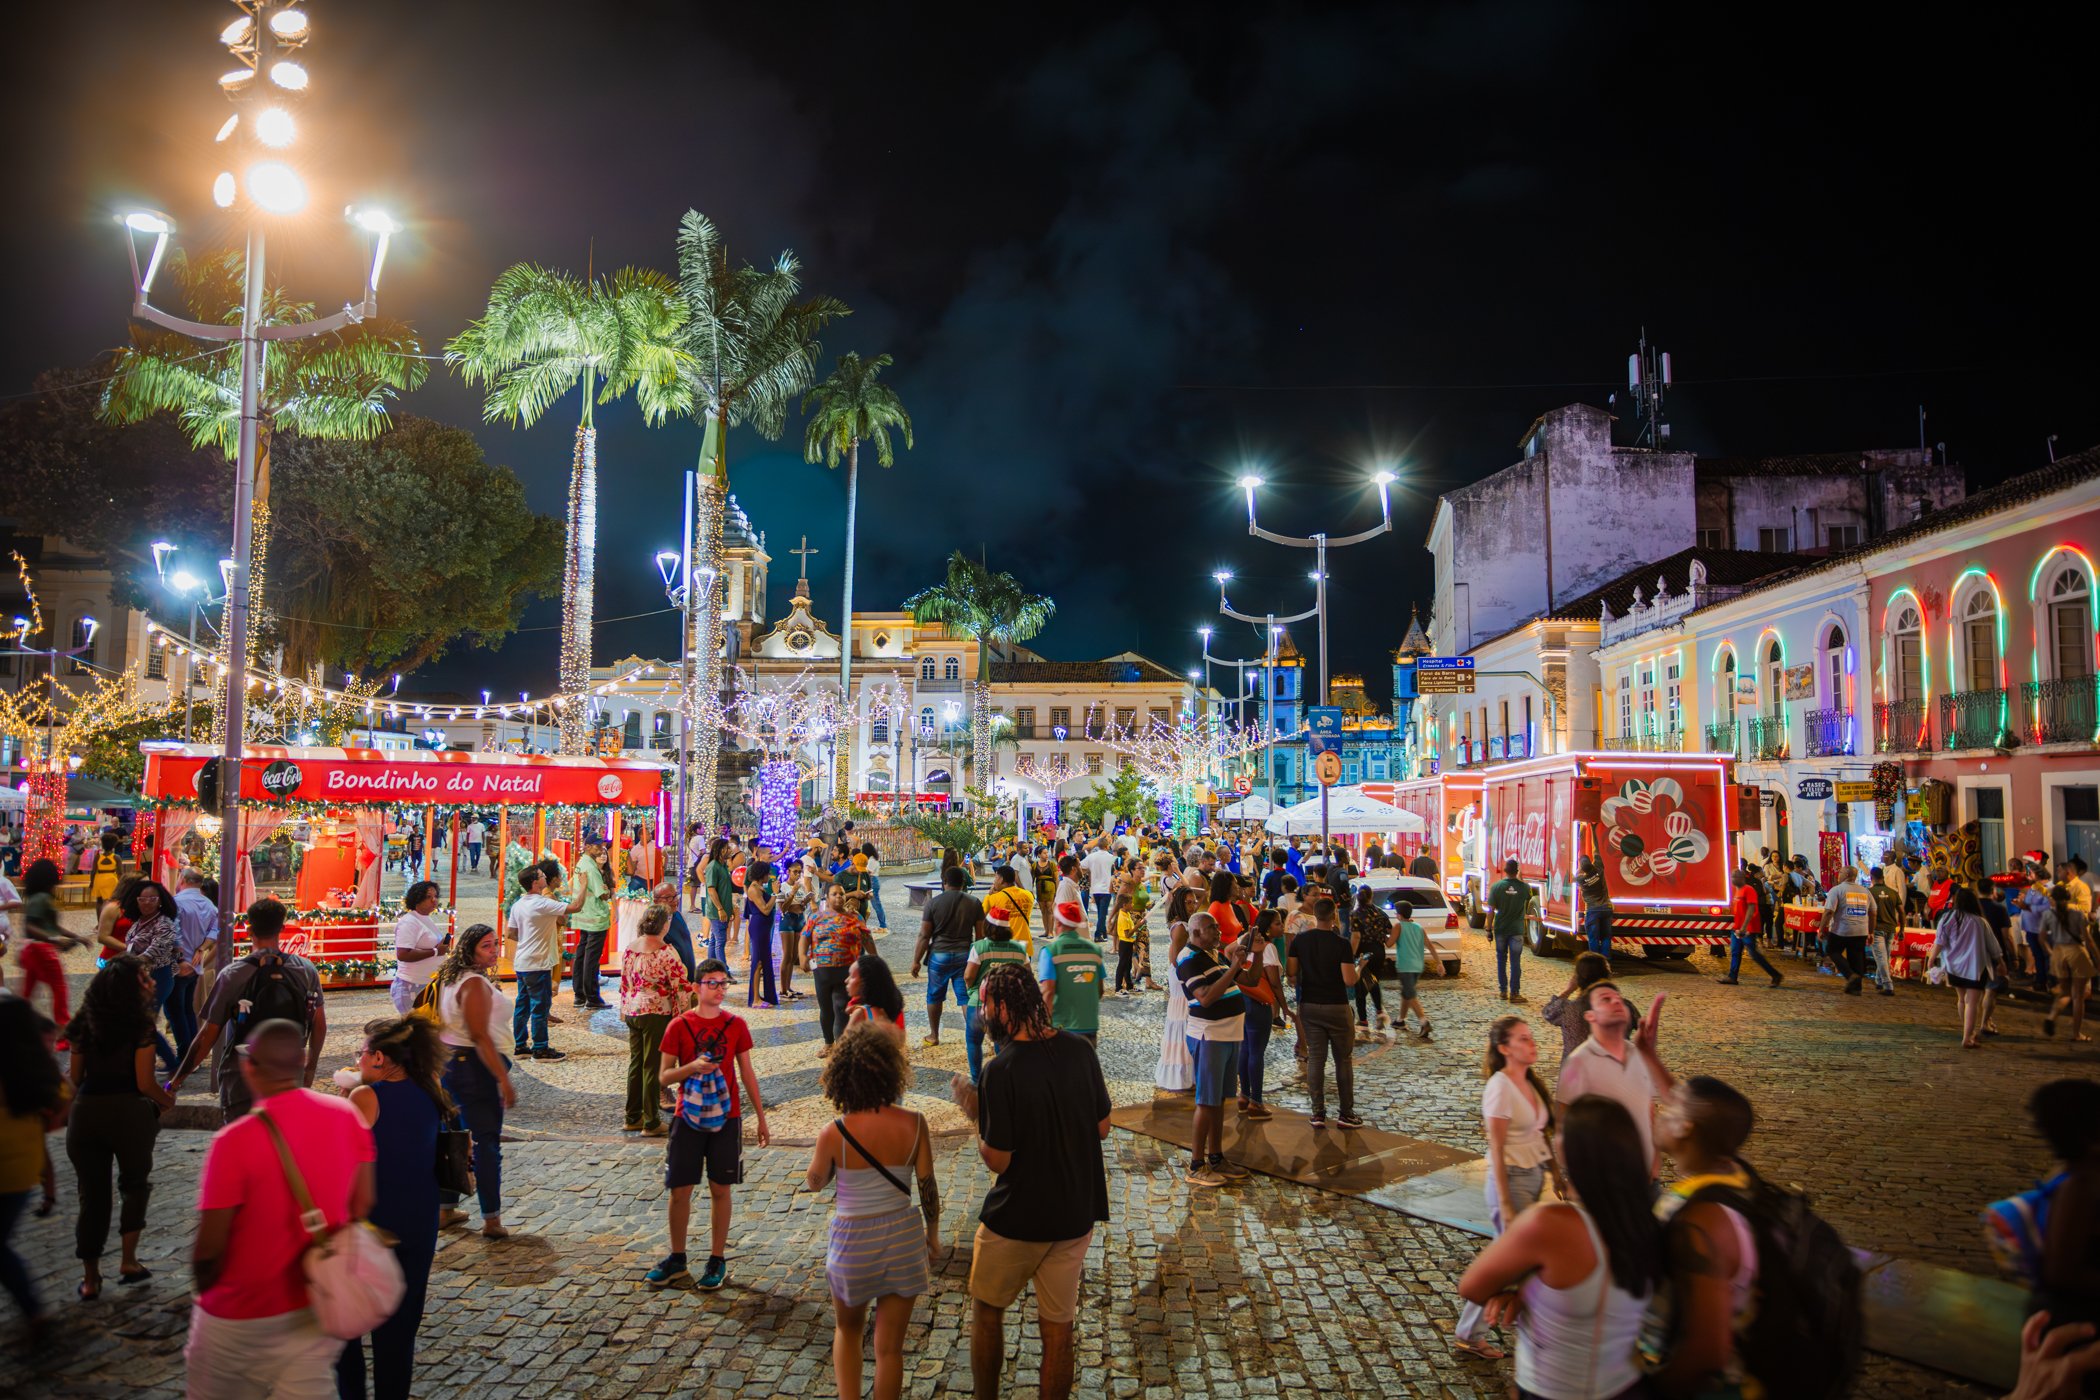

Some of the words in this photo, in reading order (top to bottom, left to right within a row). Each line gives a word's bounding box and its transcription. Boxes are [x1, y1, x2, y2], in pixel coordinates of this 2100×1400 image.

[327, 770, 438, 791] Bondinho
[446, 771, 474, 792] do
[483, 773, 543, 793] Natal
[1503, 811, 1545, 867] Coca-Cola
